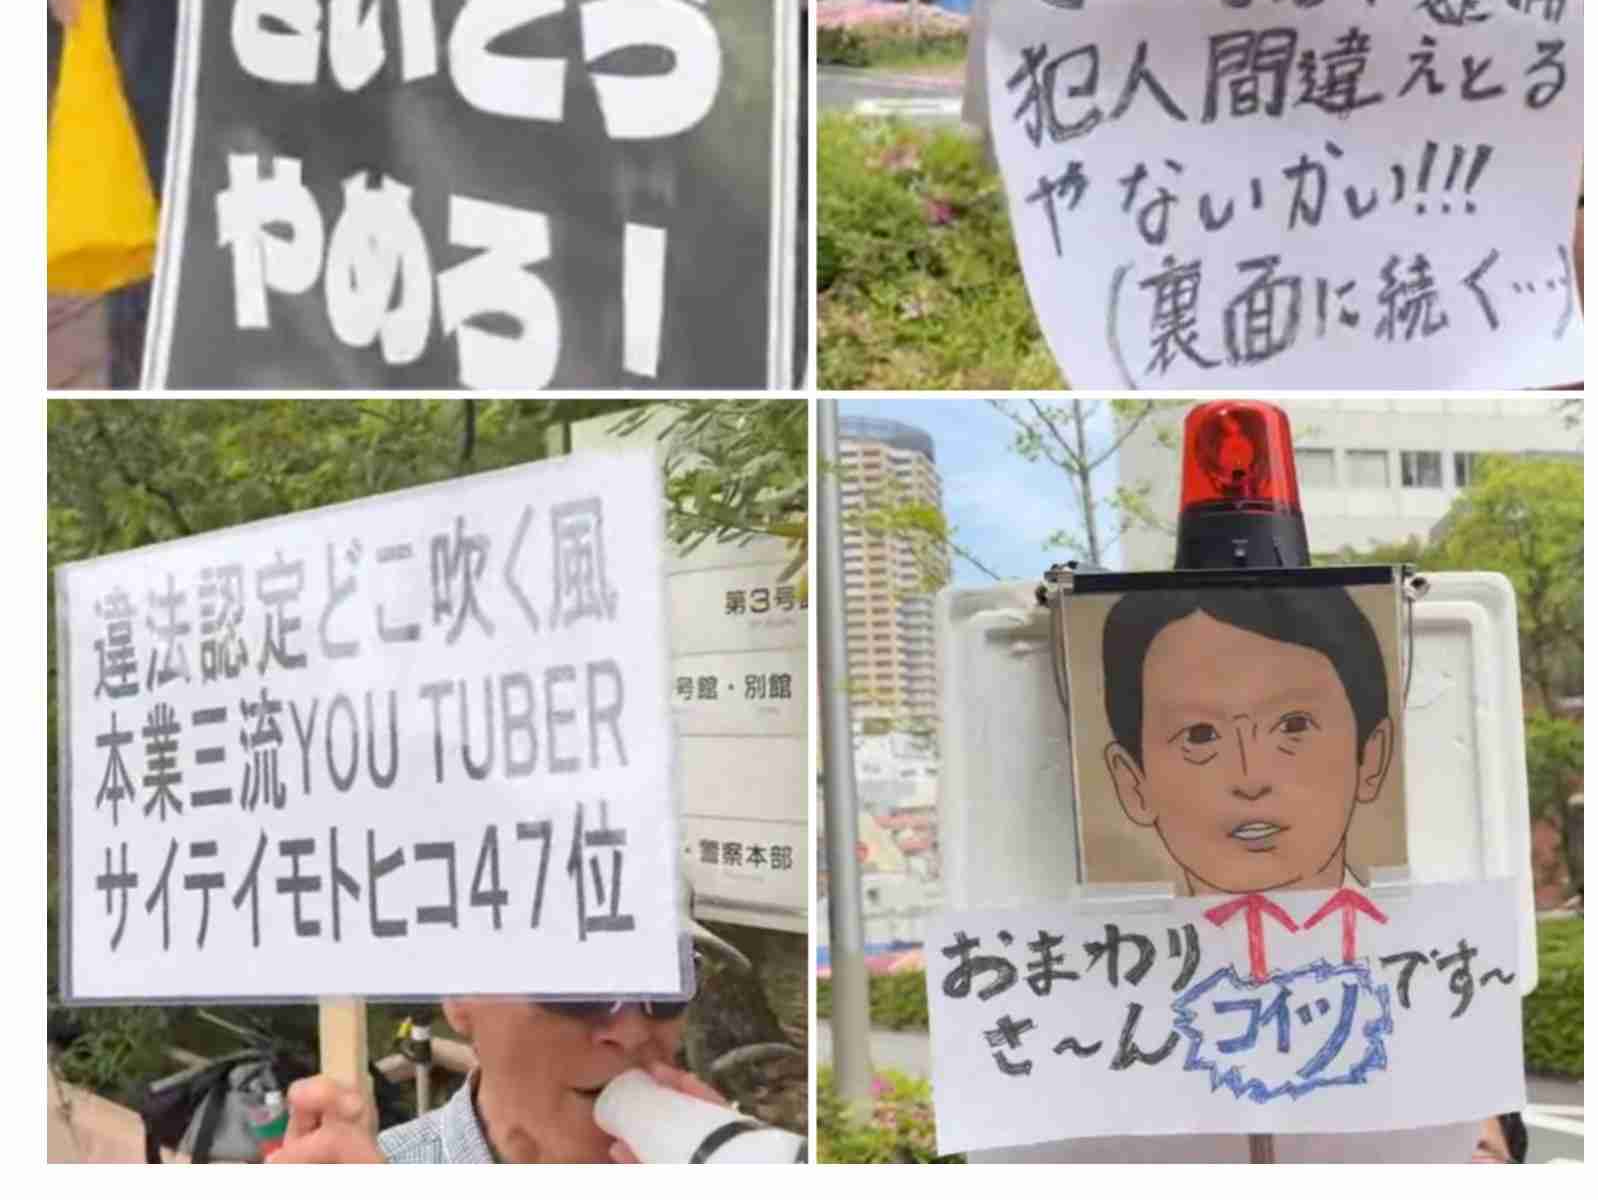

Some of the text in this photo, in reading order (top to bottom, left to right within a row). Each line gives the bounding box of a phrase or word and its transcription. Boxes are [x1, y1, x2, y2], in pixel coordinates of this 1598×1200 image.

[1006, 26, 1568, 143] 犯人間違えとる
[93, 497, 619, 699] 違法認定どこ吹く風
[725, 586, 808, 615] 第3号
[419, 659, 629, 783] TUBER
[96, 800, 635, 953] サイテイモトヒコ47位
[941, 923, 1200, 1000] おまわり
[1213, 981, 1359, 1078] コイツ
